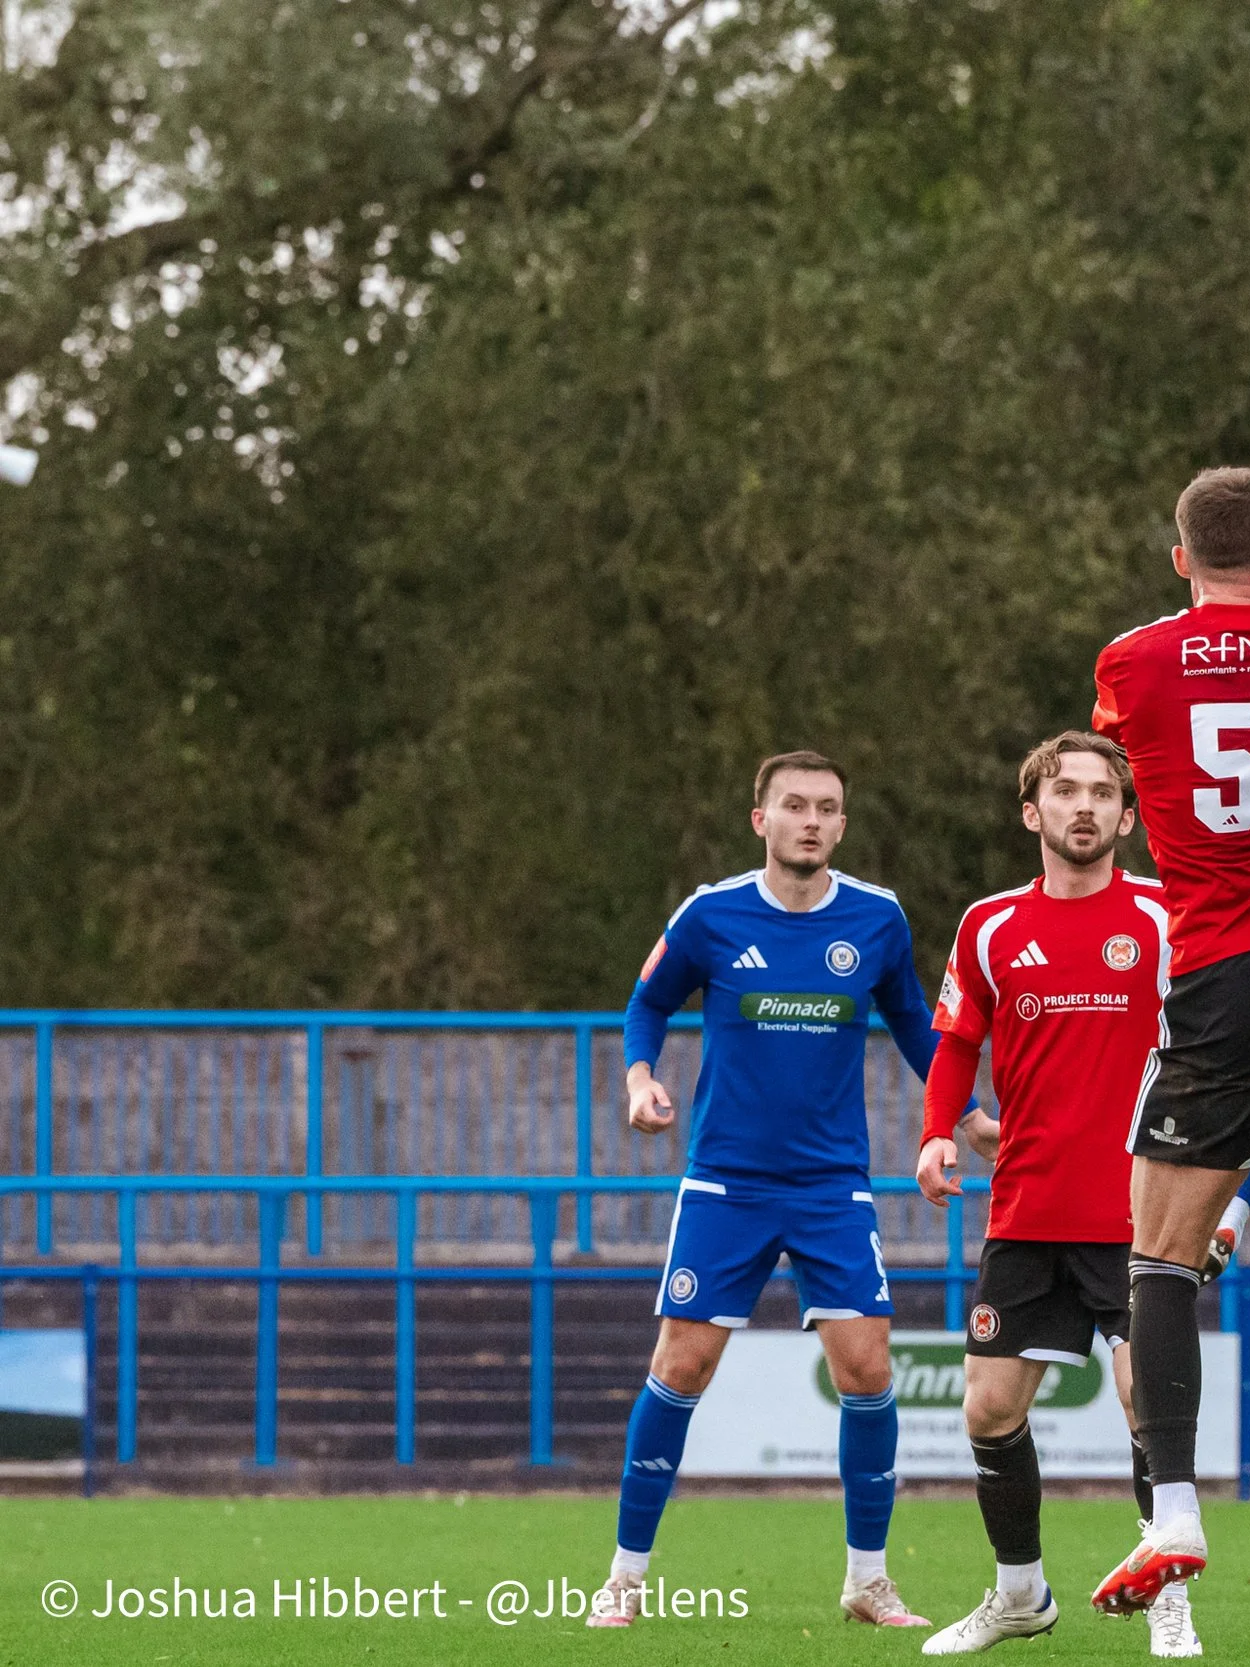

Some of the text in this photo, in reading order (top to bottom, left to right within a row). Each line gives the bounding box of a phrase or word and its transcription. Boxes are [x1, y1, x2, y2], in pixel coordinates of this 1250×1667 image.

[1183, 666, 1237, 677] Accountants
[1043, 993, 1129, 1007] PROJECT SOLAR
[757, 998, 841, 1018] Pinnacle
[757, 1021, 838, 1035] Electrical Supplies
[889, 1352, 1062, 1401] inne
